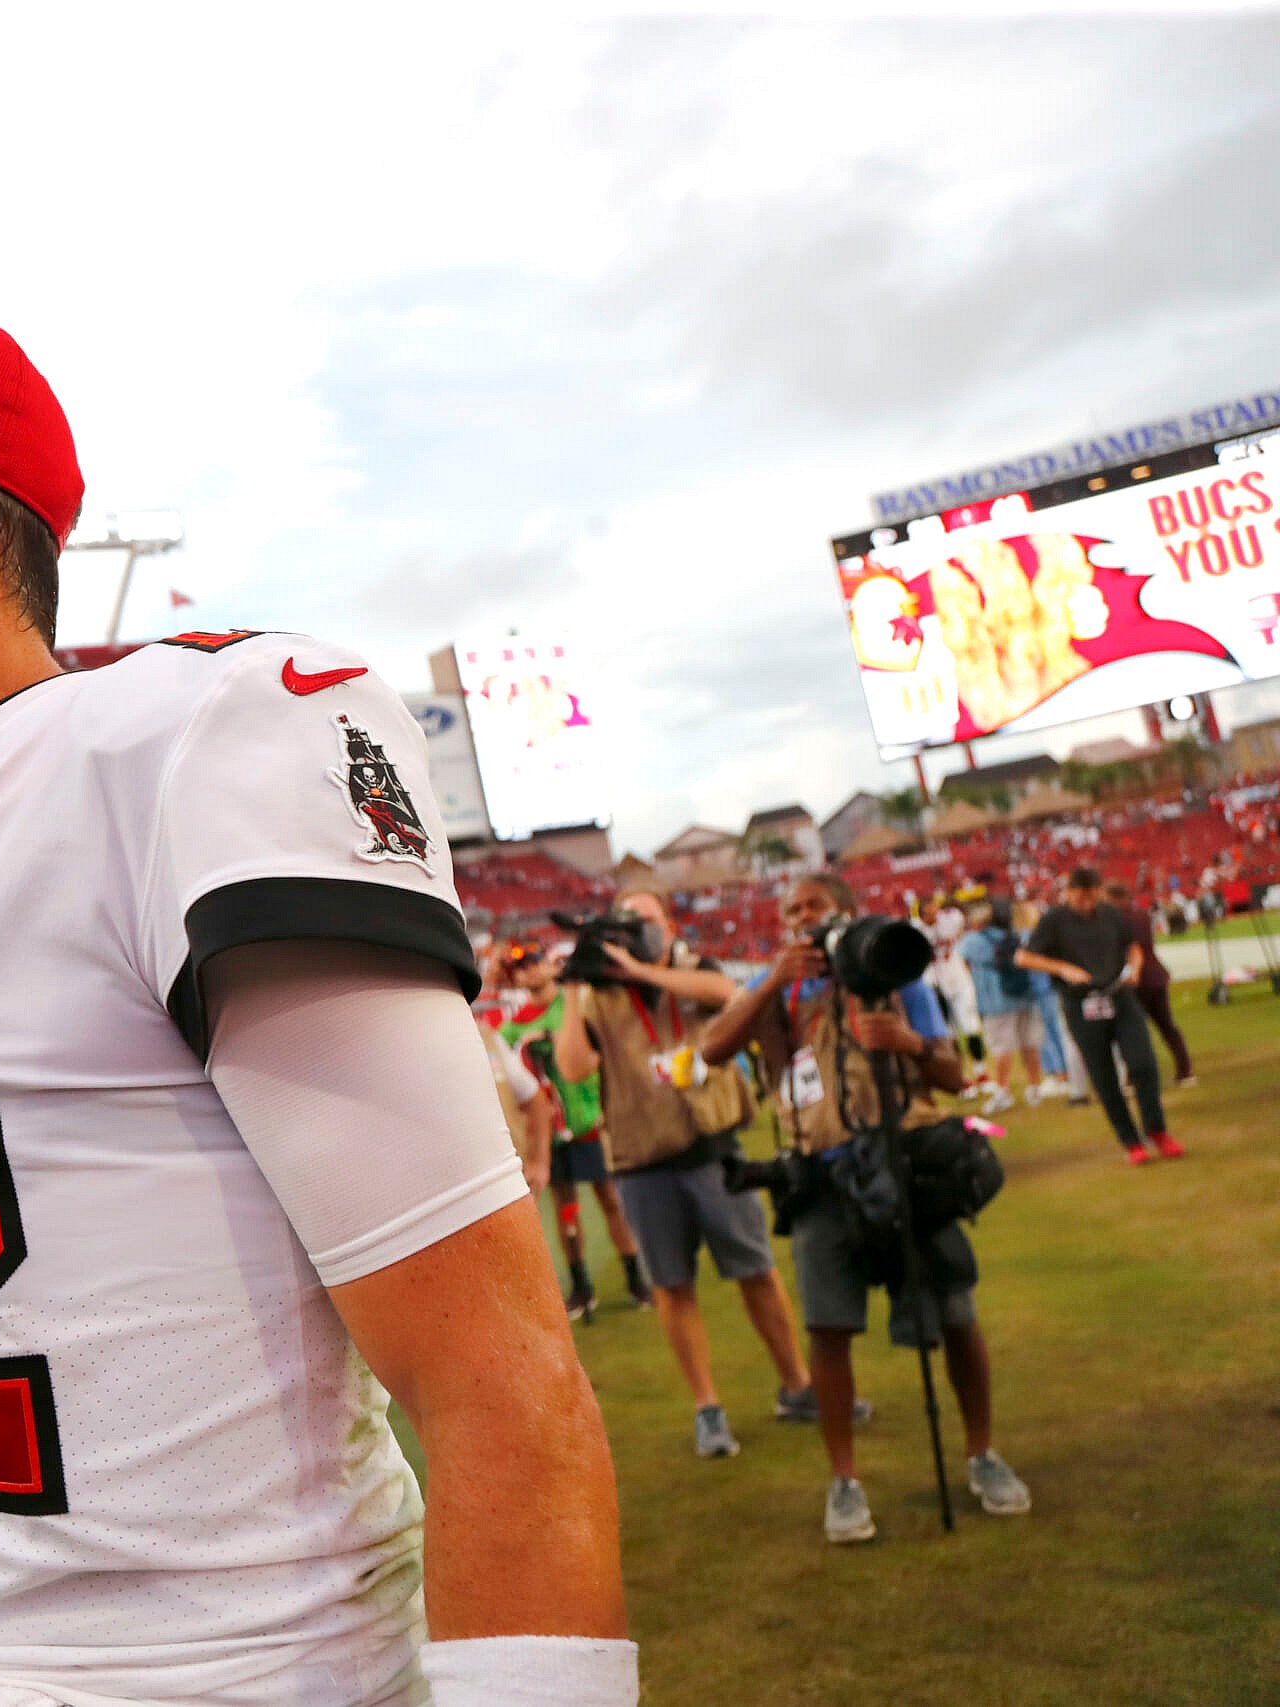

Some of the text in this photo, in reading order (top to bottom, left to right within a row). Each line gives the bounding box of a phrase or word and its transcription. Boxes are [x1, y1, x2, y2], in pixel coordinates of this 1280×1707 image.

[878, 452, 1057, 518] RAYMOND
[1062, 418, 1183, 471] JAMES
[1147, 471, 1274, 538] BUCS
[1165, 524, 1265, 583] YOU
